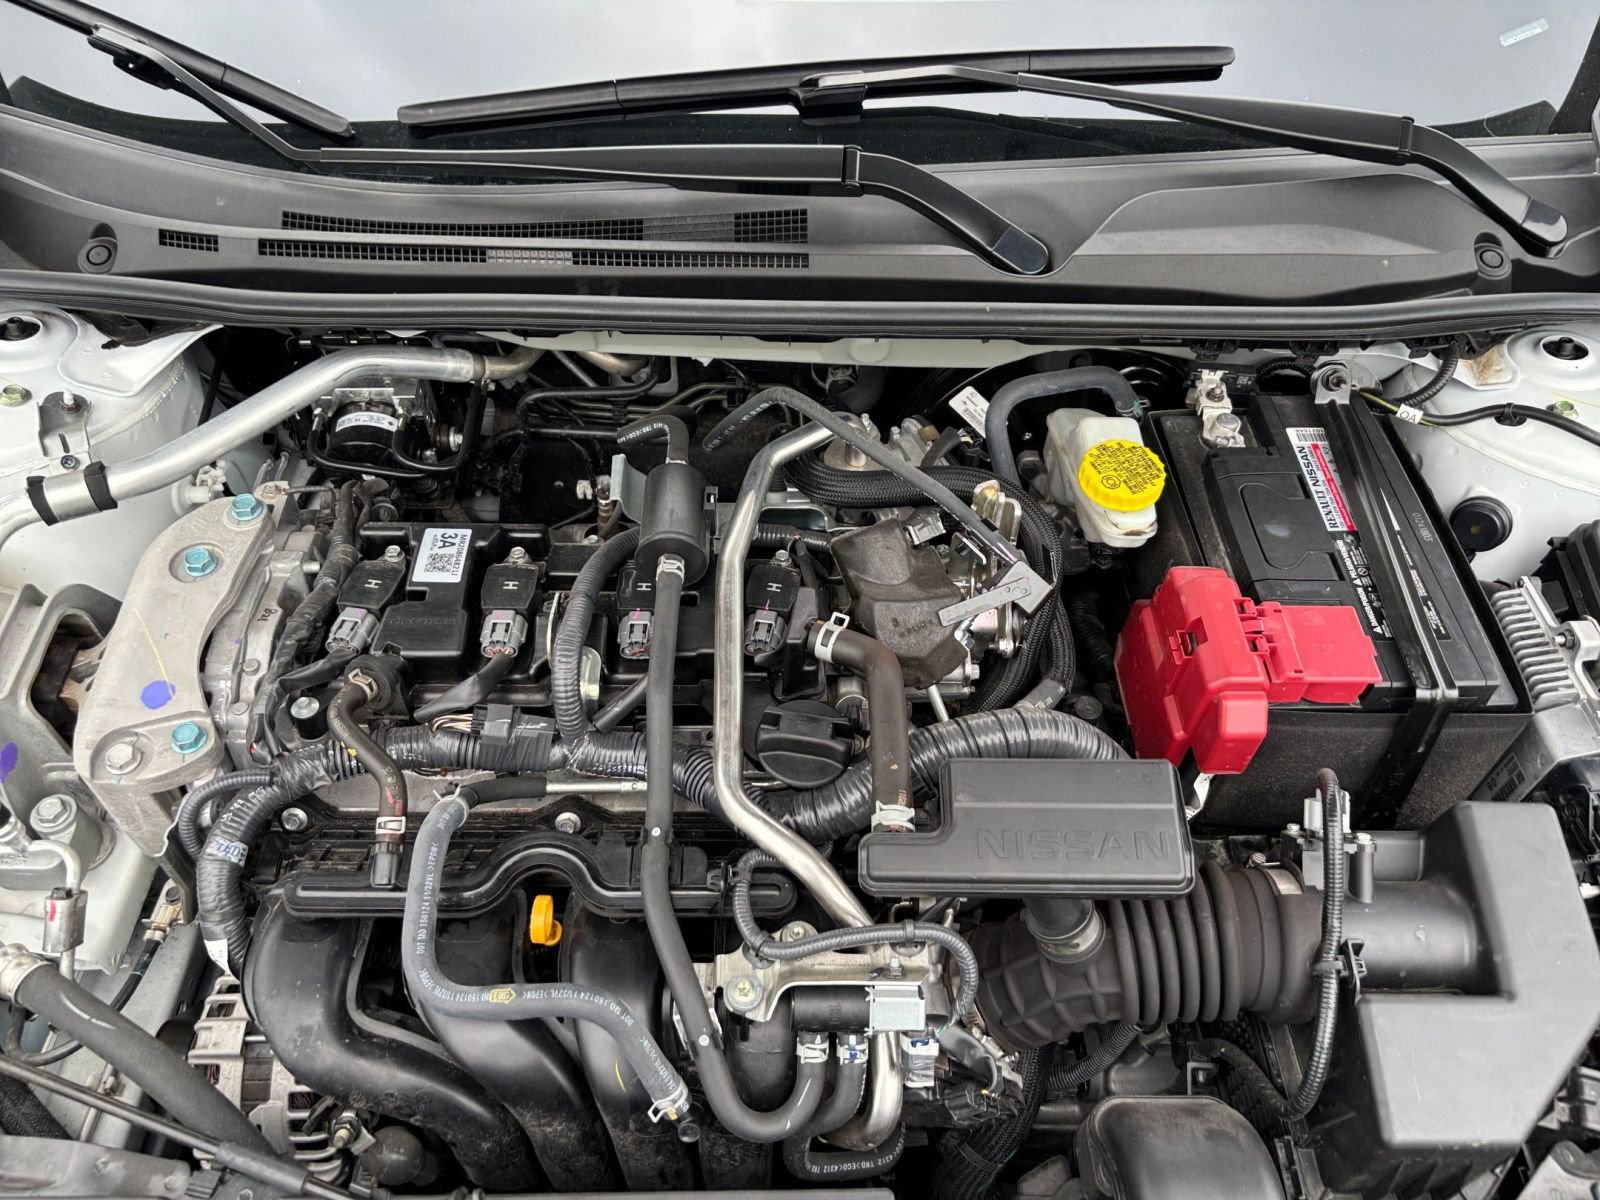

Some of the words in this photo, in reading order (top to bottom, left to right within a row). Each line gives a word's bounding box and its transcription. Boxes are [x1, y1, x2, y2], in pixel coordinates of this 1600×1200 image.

[1297, 445, 1322, 487] NISSAN
[1316, 489, 1340, 528] RENAULT
[437, 532, 459, 550] 3A
[364, 578, 383, 589] H
[502, 580, 519, 590] H
[636, 582, 652, 591] H
[766, 582, 783, 592] H
[976, 828, 1170, 860] NISSAN
